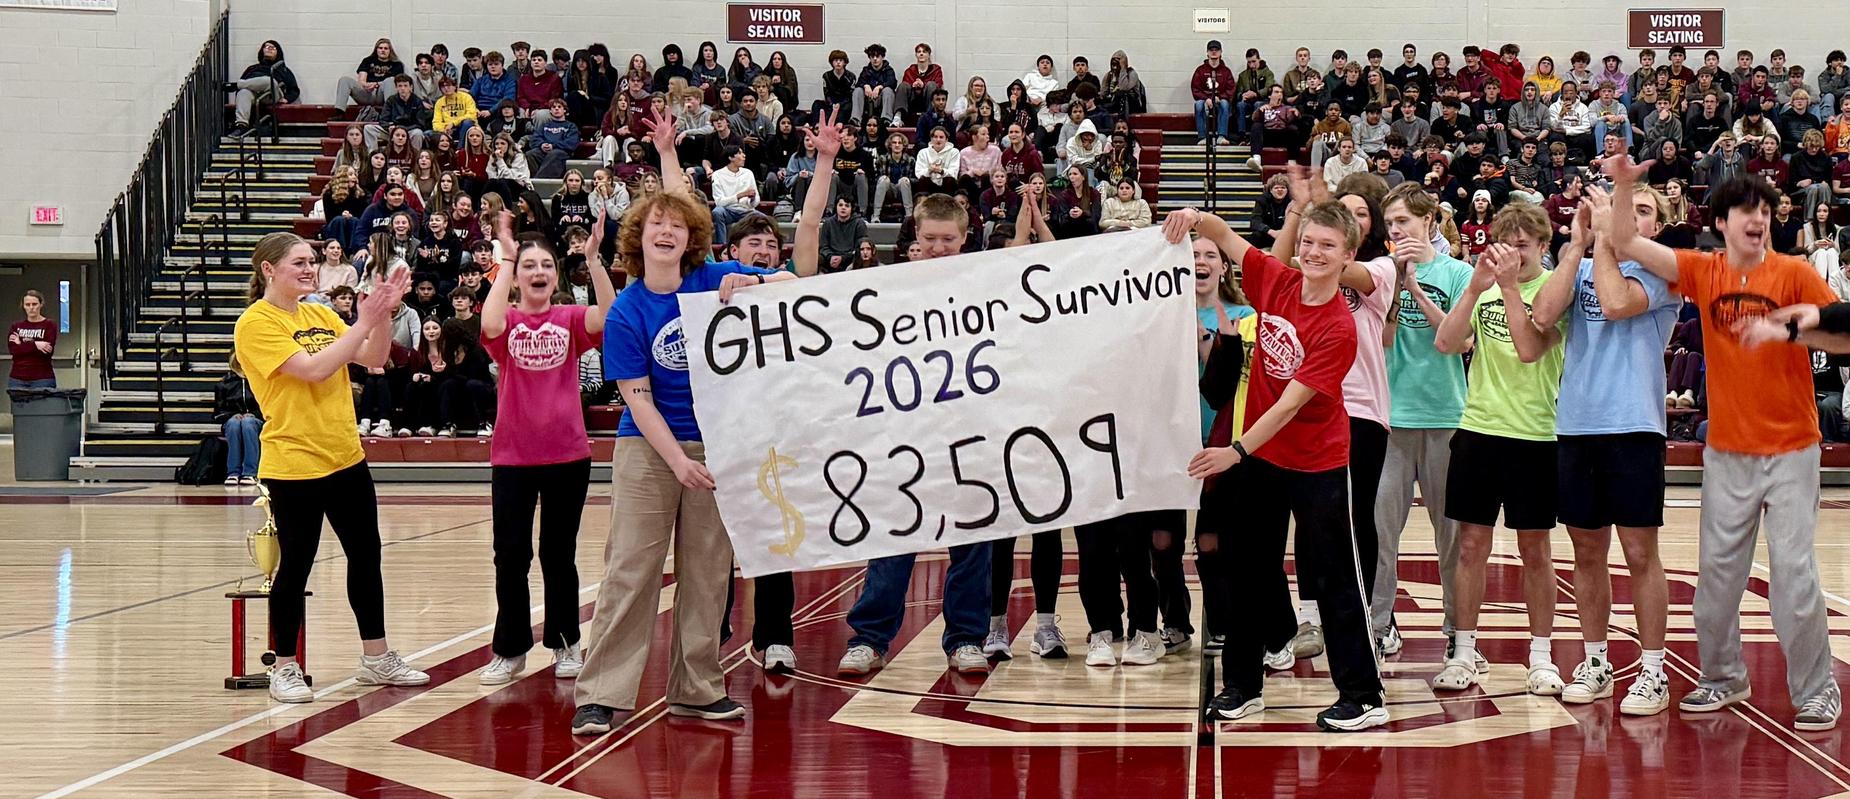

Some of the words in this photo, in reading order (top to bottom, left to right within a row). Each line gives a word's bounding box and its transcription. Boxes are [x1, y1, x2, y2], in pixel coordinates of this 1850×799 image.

[749, 8, 801, 22] VISITOR
[1650, 14, 1702, 27] VISITOR
[747, 24, 804, 38] SEATING
[1648, 31, 1704, 43] SEATING
[36, 207, 58, 222] EXIT
[705, 295, 832, 375] GHS
[851, 289, 1008, 351] Senior
[1020, 264, 1191, 324] Survivor
[845, 339, 1001, 418] 2026
[757, 413, 1124, 558] $83,509
